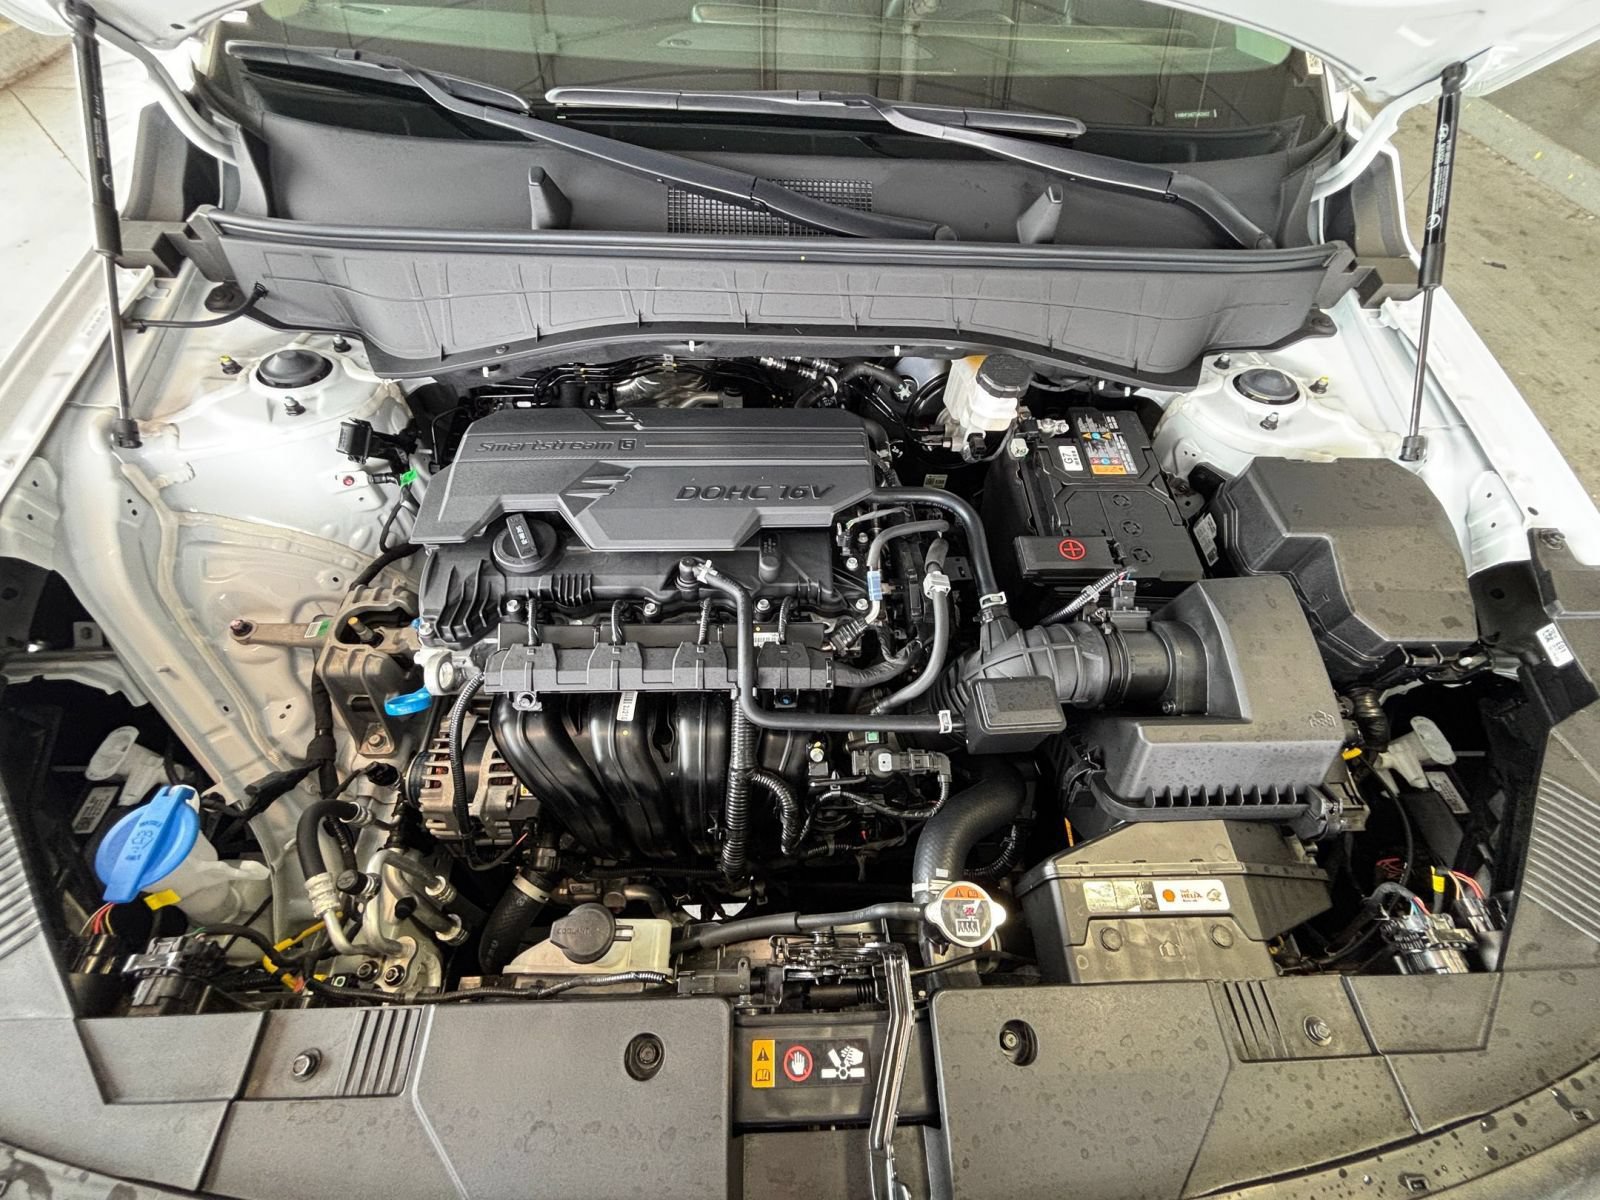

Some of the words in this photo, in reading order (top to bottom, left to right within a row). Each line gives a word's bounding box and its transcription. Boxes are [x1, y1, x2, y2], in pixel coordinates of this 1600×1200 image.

[476, 439, 614, 452] Smartstream
[674, 485, 773, 501] DOHC
[778, 484, 836, 501] 16V
